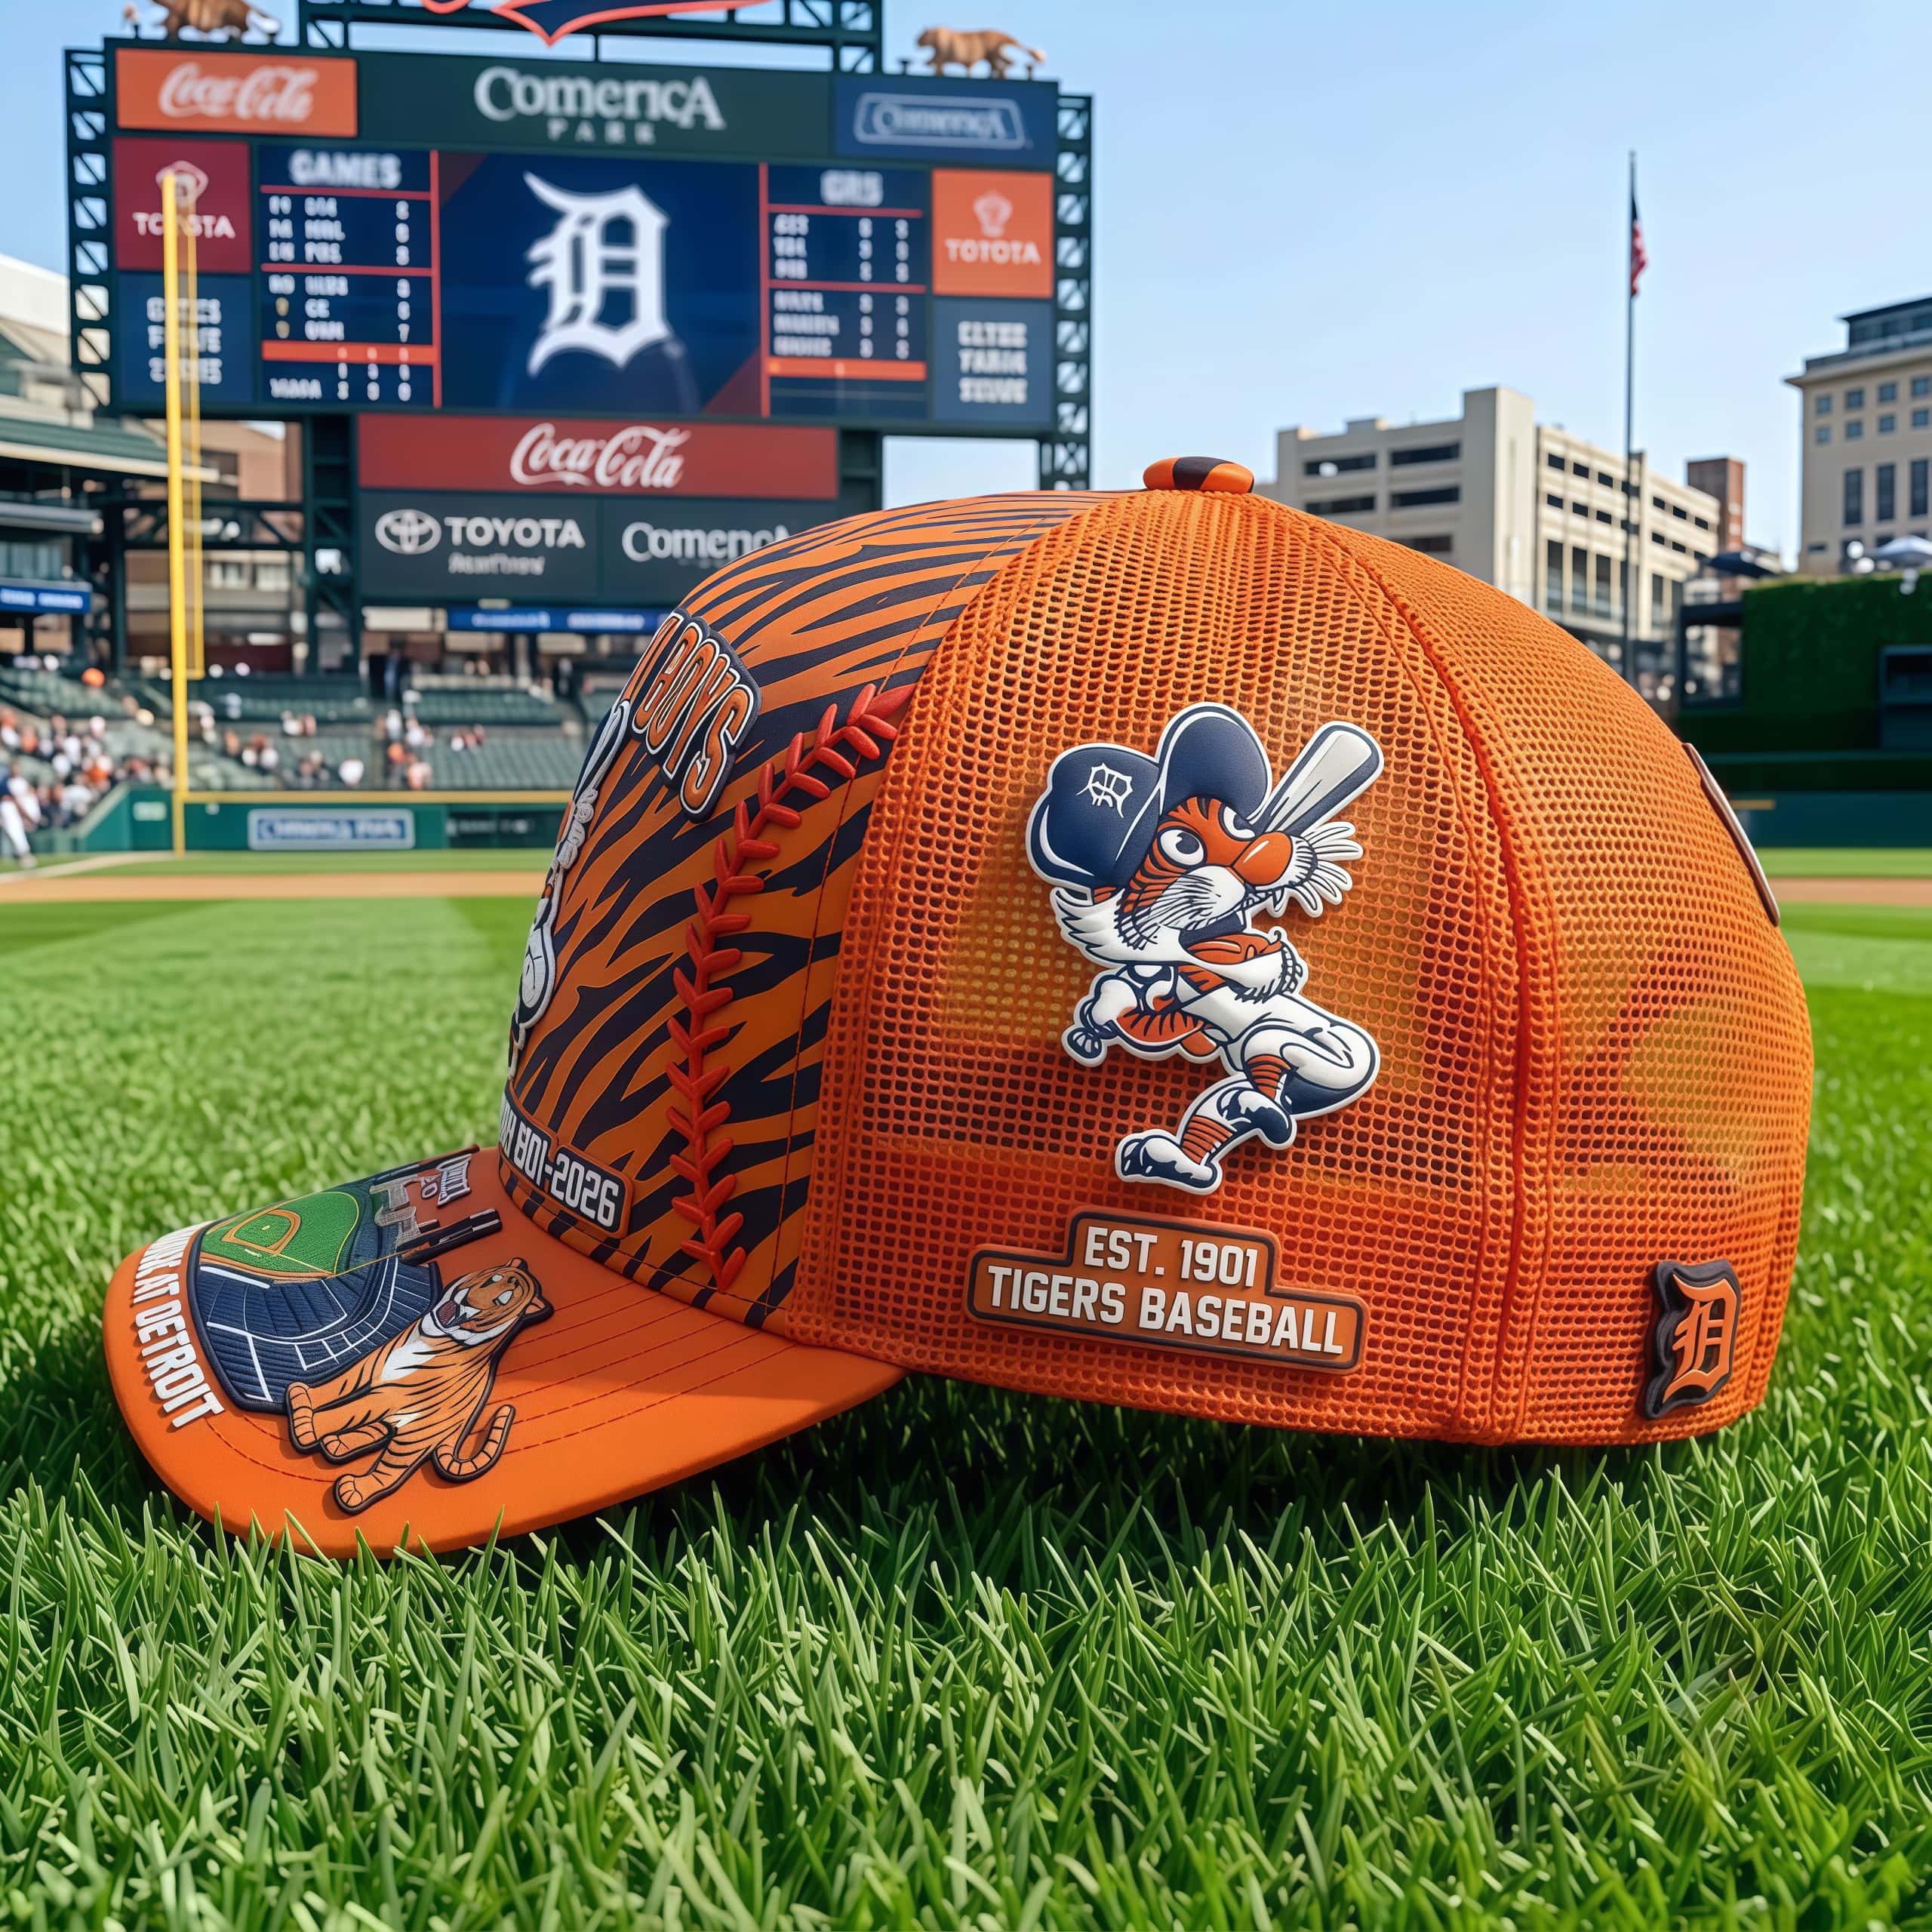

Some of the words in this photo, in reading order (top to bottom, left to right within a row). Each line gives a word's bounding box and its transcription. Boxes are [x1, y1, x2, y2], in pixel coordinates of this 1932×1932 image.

[523, 170, 672, 377] D
[444, 516, 586, 549] TOYOTA
[133, 1272, 180, 1305] AT
[1084, 1225, 1166, 1276] EST.
[1180, 1238, 1259, 1288] 1901
[987, 1265, 1127, 1324] TIGERS
[1138, 1286, 1344, 1355] BASEBALL
[1662, 1272, 1738, 1404] D
[135, 1299, 226, 1429] DETROIT
